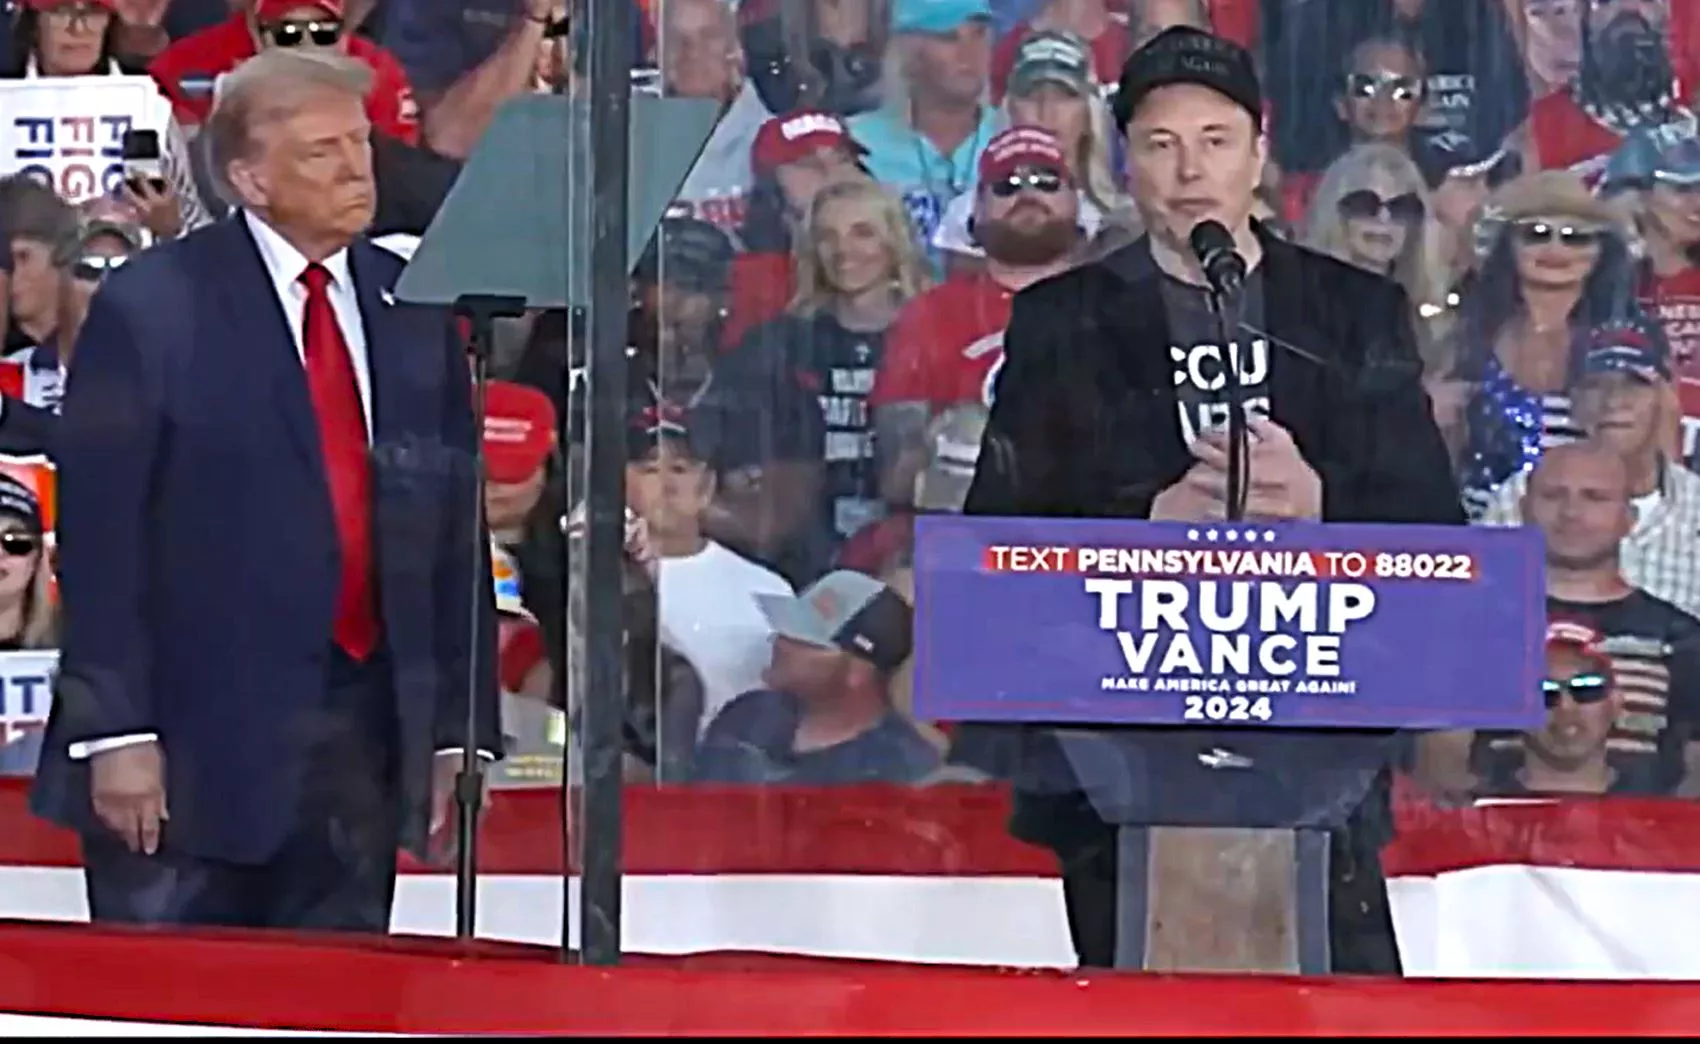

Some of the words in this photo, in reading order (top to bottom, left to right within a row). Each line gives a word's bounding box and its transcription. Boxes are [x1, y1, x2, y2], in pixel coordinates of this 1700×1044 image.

[990, 545, 1070, 572] TEXT
[1077, 548, 1317, 577] PENNSYLVANIA
[1325, 552, 1367, 577] TO
[1374, 552, 1472, 579] 88022
[1084, 578, 1376, 634] TRUMP
[1116, 631, 1341, 677] VANCE
[1101, 677, 1149, 691] MAKE
[1153, 678, 1231, 693] AMERICA
[1235, 679, 1291, 693] GREAT
[1295, 680, 1357, 695] AGAIN!
[1183, 695, 1273, 721] 2024
